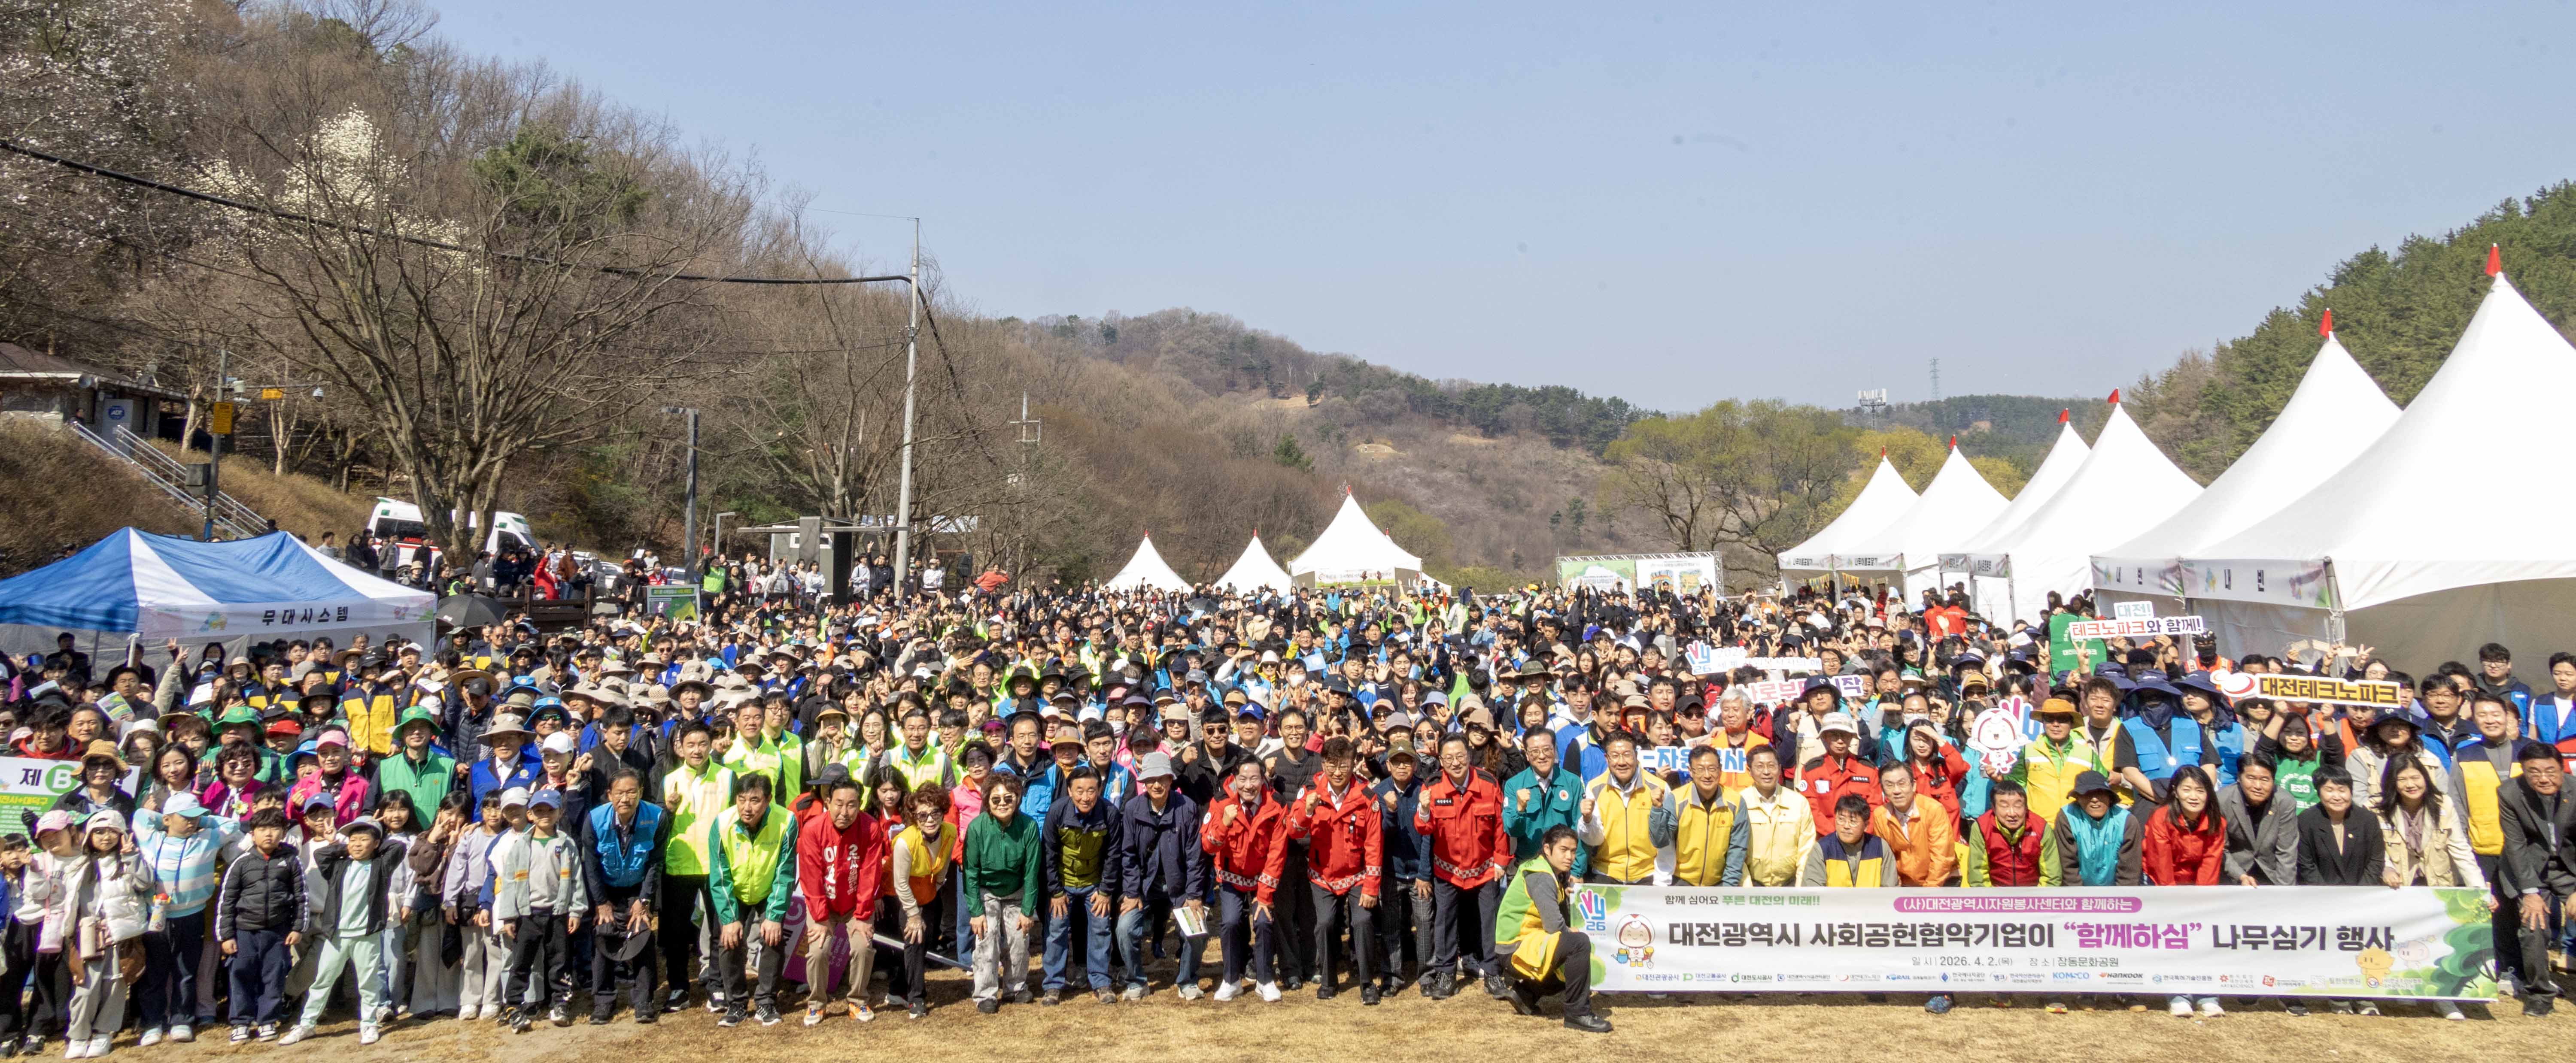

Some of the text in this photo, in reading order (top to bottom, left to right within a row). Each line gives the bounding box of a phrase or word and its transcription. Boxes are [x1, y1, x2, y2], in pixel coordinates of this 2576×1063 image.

[262, 606, 348, 626] 무대시스템
[2117, 604, 2151, 618] 대전!
[2072, 620, 2162, 636] 테크노파크와
[2166, 618, 2201, 633] 함께!
[1693, 665, 1712, 673] 26
[2259, 677, 2399, 704] 대전테크노파크
[20, 768, 43, 787] 제
[2290, 784, 2310, 793] ESG
[0, 795, 49, 805] 전시+대덕구
[1665, 895, 1820, 906] 함께 심어요 푸른 대전의 미래!!
[1903, 898, 2132, 911] (사)대전광역시자원봉사센터와 함께하는
[1586, 921, 1606, 931] 26
[1668, 921, 2395, 952] 대전광역시 사회공헌협약기업이 “함께하심” 나무심기 행사
[1940, 956, 1971, 966] 2026.
[2058, 957, 2119, 967] 장동문화공원
